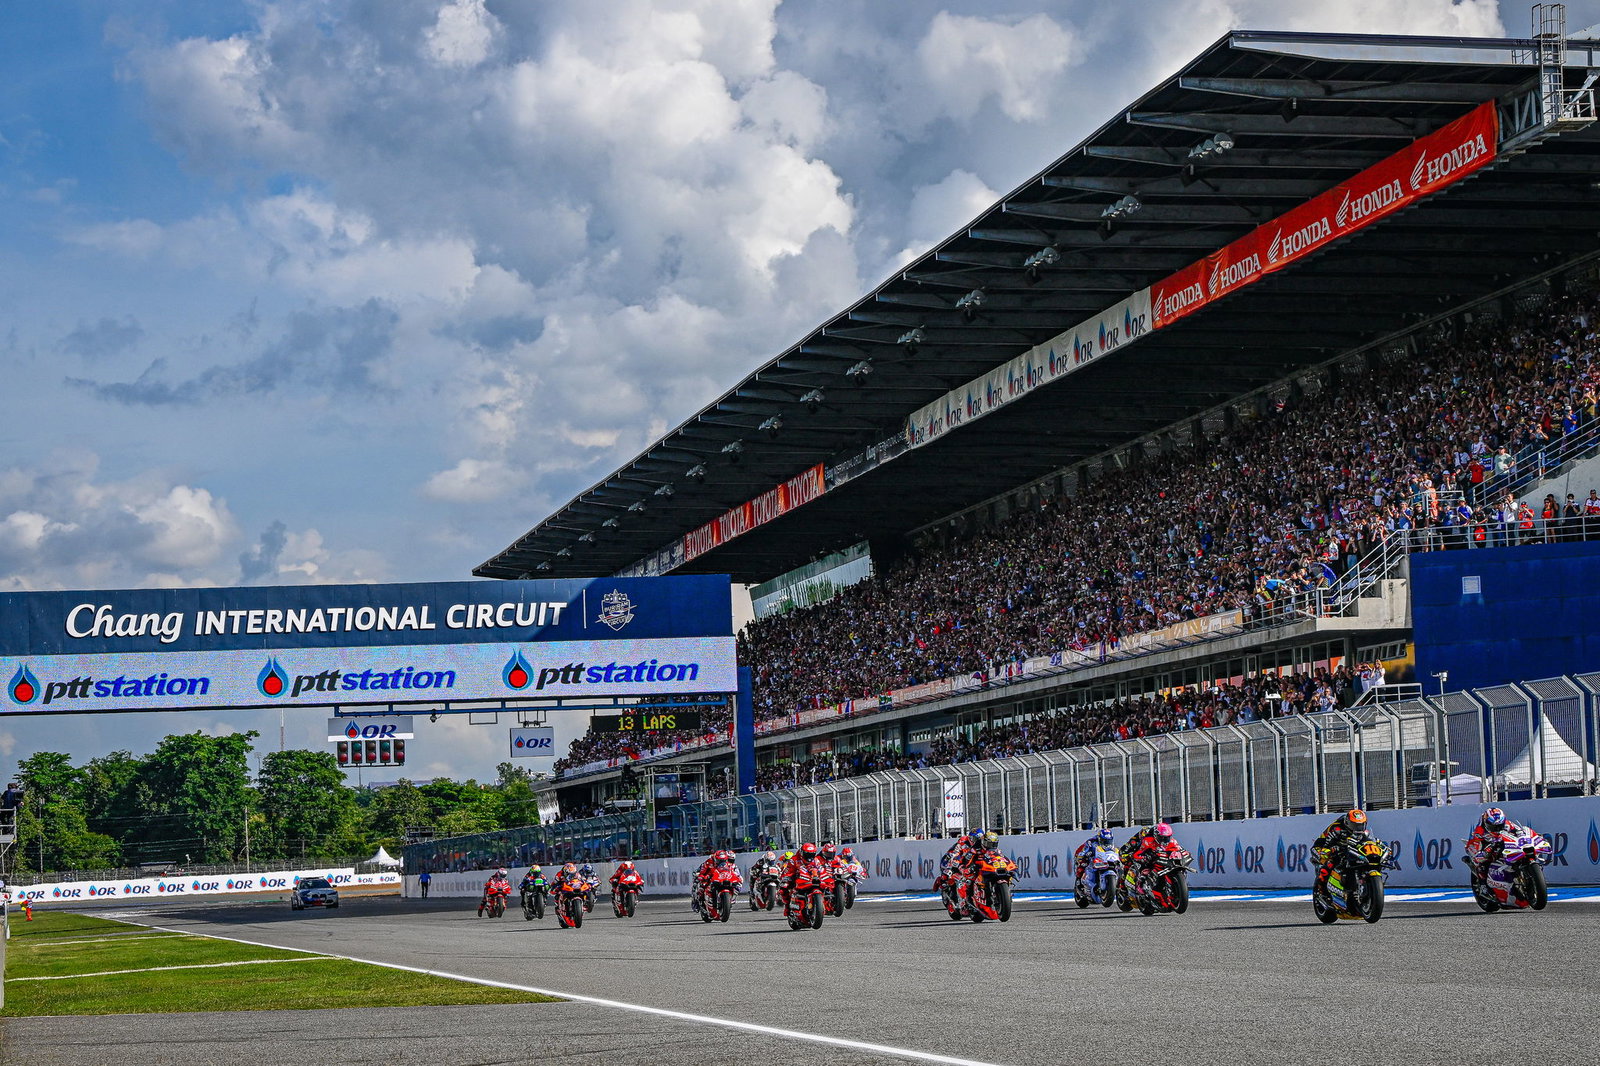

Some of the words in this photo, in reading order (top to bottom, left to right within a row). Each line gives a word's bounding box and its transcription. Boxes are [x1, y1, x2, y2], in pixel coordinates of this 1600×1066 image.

[1164, 282, 1203, 317] HONDA
[1219, 252, 1262, 292] HONDA
[1281, 217, 1332, 258] HONDA
[1350, 178, 1404, 222] HONDA
[1425, 133, 1488, 184] HONDA
[788, 467, 819, 508] TOYOTA
[65, 603, 184, 643] Chang
[194, 606, 436, 636] INTERNATIONAL
[446, 601, 568, 629] CIRCUIT
[361, 723, 397, 740] OR
[618, 716, 634, 731] 13
[643, 714, 676, 730] LAPS
[525, 737, 552, 749] OR
[880, 858, 891, 877] OR
[901, 859, 912, 880] OR
[923, 858, 935, 880] OR
[1043, 854, 1058, 878] OR
[1207, 847, 1225, 874] OR
[1245, 845, 1264, 873] OR
[1287, 843, 1308, 872] OR
[1426, 838, 1453, 870] OR
[1364, 843, 1381, 855] 10
[62, 888, 81, 898] OR
[97, 886, 116, 896] OR
[132, 885, 151, 894] OR
[167, 883, 185, 893] OR
[201, 881, 219, 891] OR
[235, 880, 253, 889] OR
[268, 878, 286, 888] OR
[334, 874, 352, 884] OR
